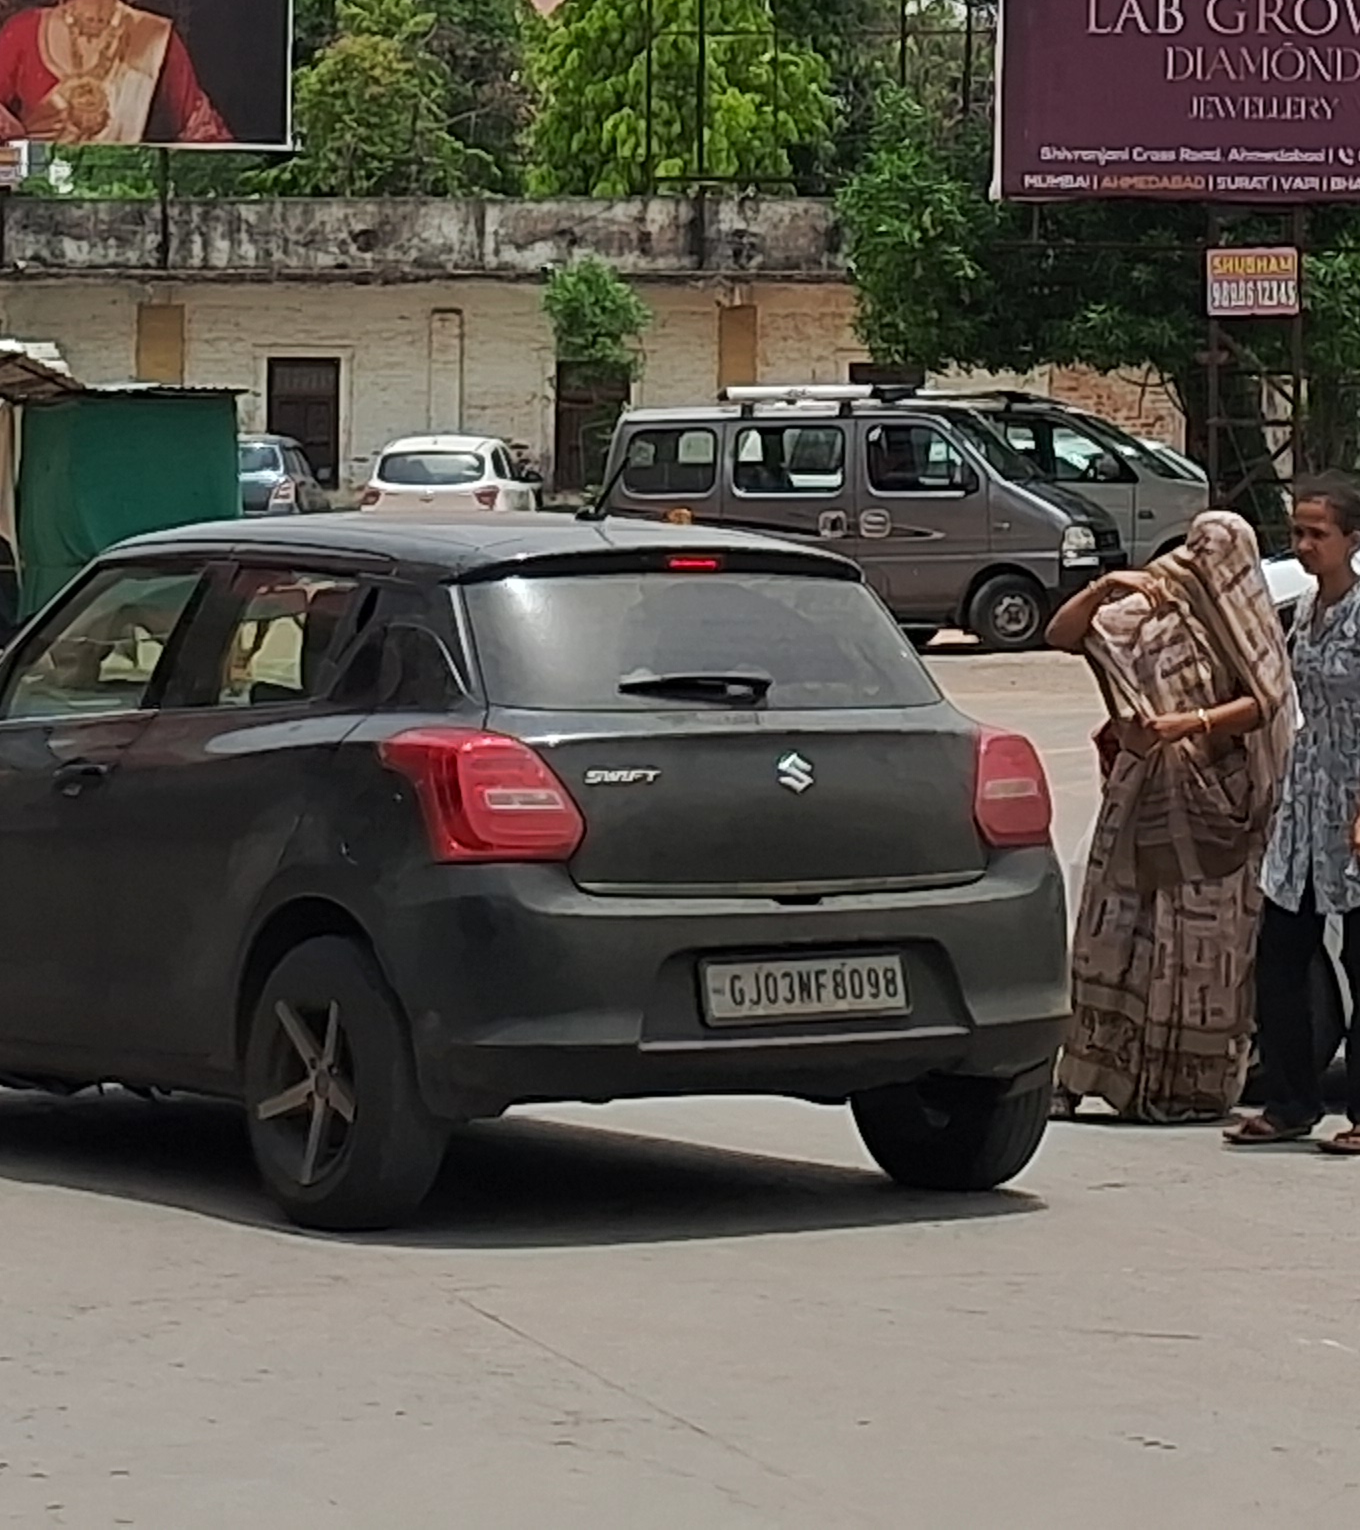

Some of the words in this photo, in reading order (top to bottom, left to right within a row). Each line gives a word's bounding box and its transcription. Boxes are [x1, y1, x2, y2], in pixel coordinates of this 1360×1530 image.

[1188, 95, 1339, 121] JEWELLERY
[1024, 174, 1090, 188] MUMBAI
[1100, 175, 1206, 190] AHMEDABAD
[1216, 175, 1269, 191] SURAT
[584, 769, 662, 784] SWIFT
[729, 967, 899, 1008] GJ03NF8098
